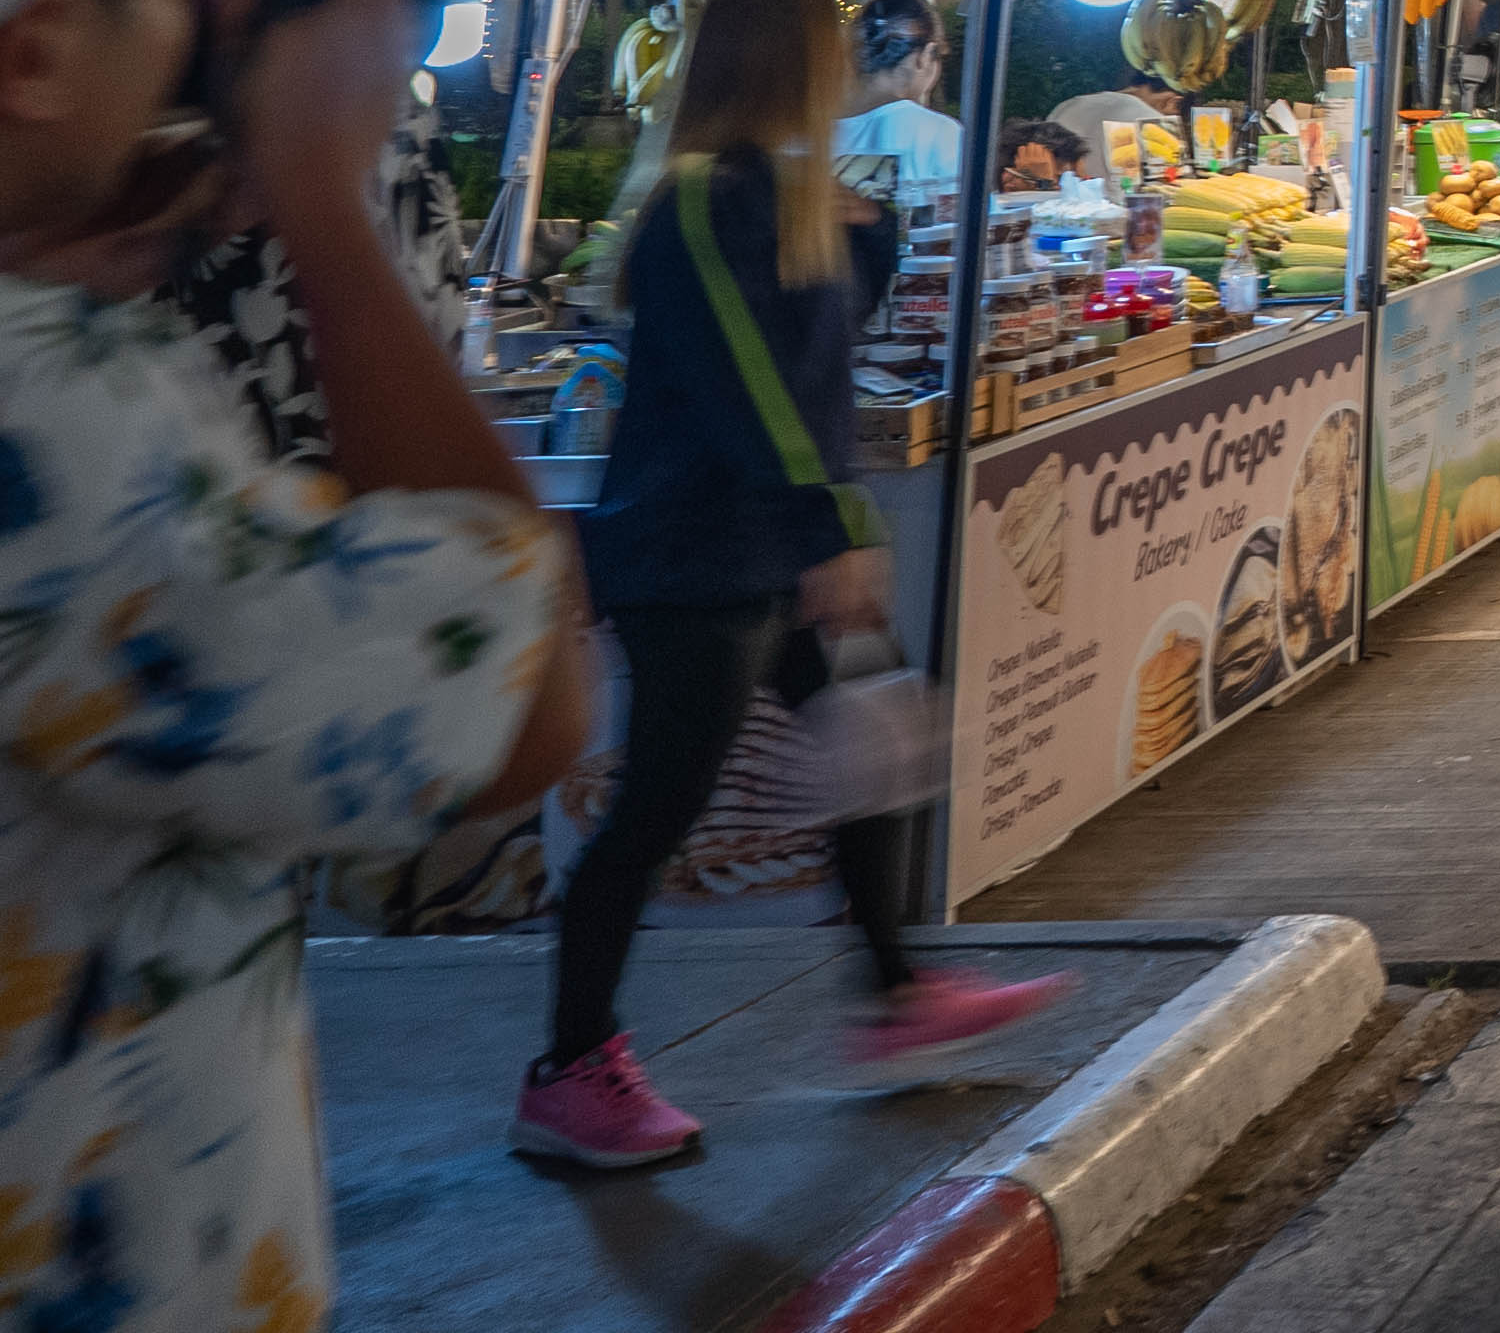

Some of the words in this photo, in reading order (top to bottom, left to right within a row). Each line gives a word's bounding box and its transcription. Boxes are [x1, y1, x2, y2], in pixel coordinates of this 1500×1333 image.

[1090, 457, 1192, 536] Crepe
[1199, 419, 1287, 491] Crepe
[1134, 526, 1193, 582] Bakery
[1210, 501, 1248, 544] Cake
